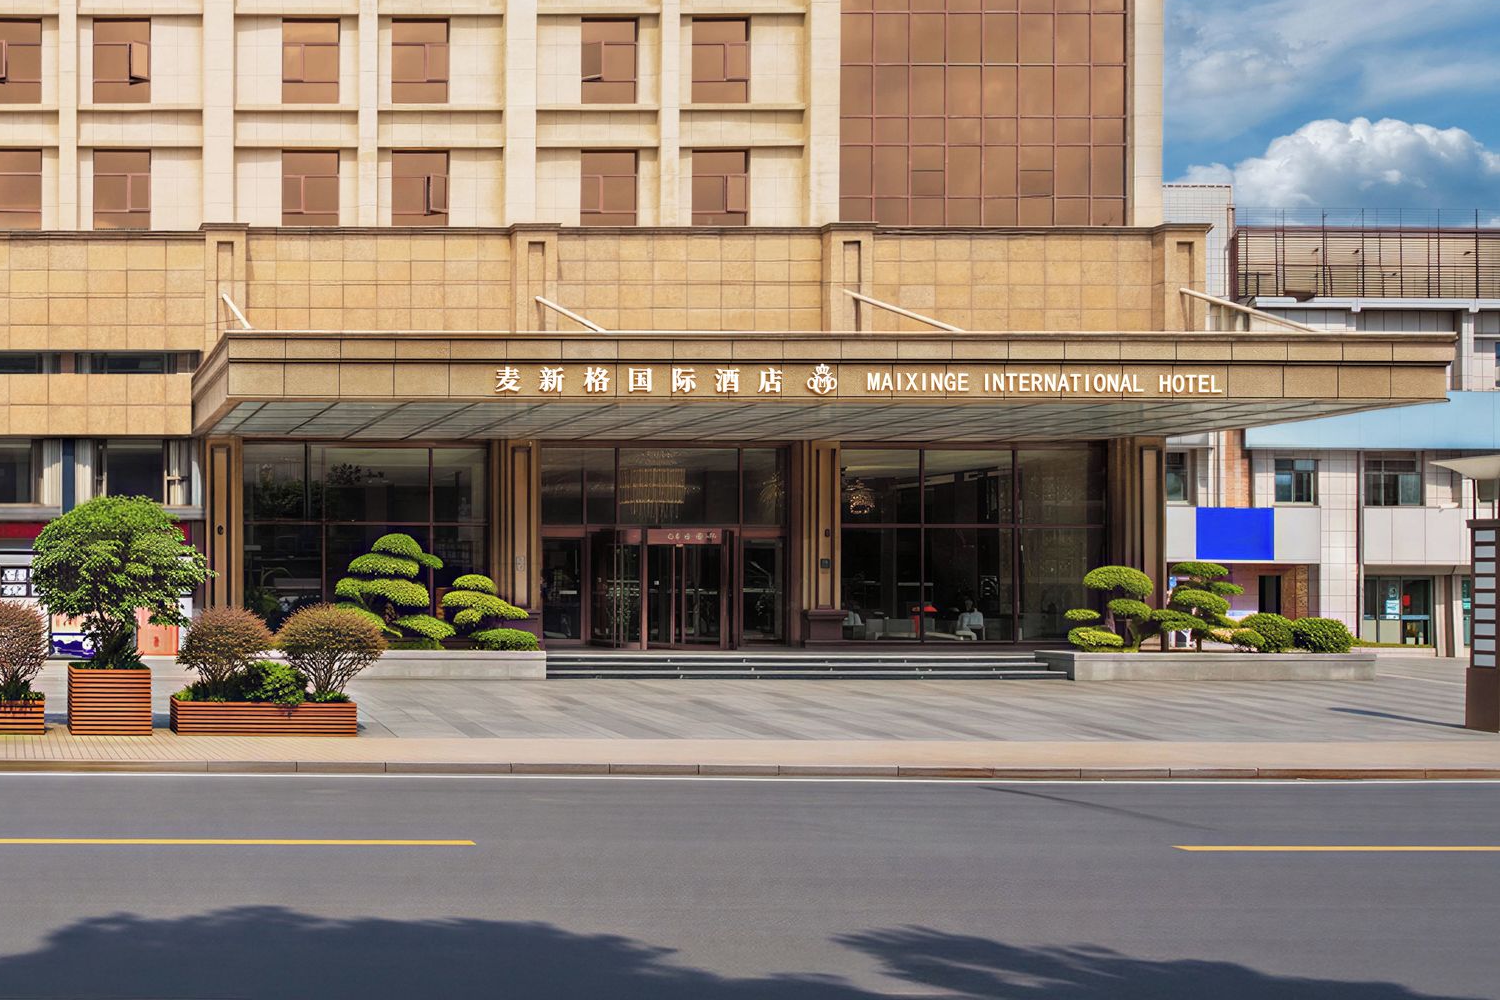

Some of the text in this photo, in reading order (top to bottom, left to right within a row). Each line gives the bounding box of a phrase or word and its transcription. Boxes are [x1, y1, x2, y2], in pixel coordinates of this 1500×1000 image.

[495, 366, 783, 393] 麦新格国际酒店
[866, 372, 1223, 394] MAIXINGE INTERNATIONAL HOTEL
